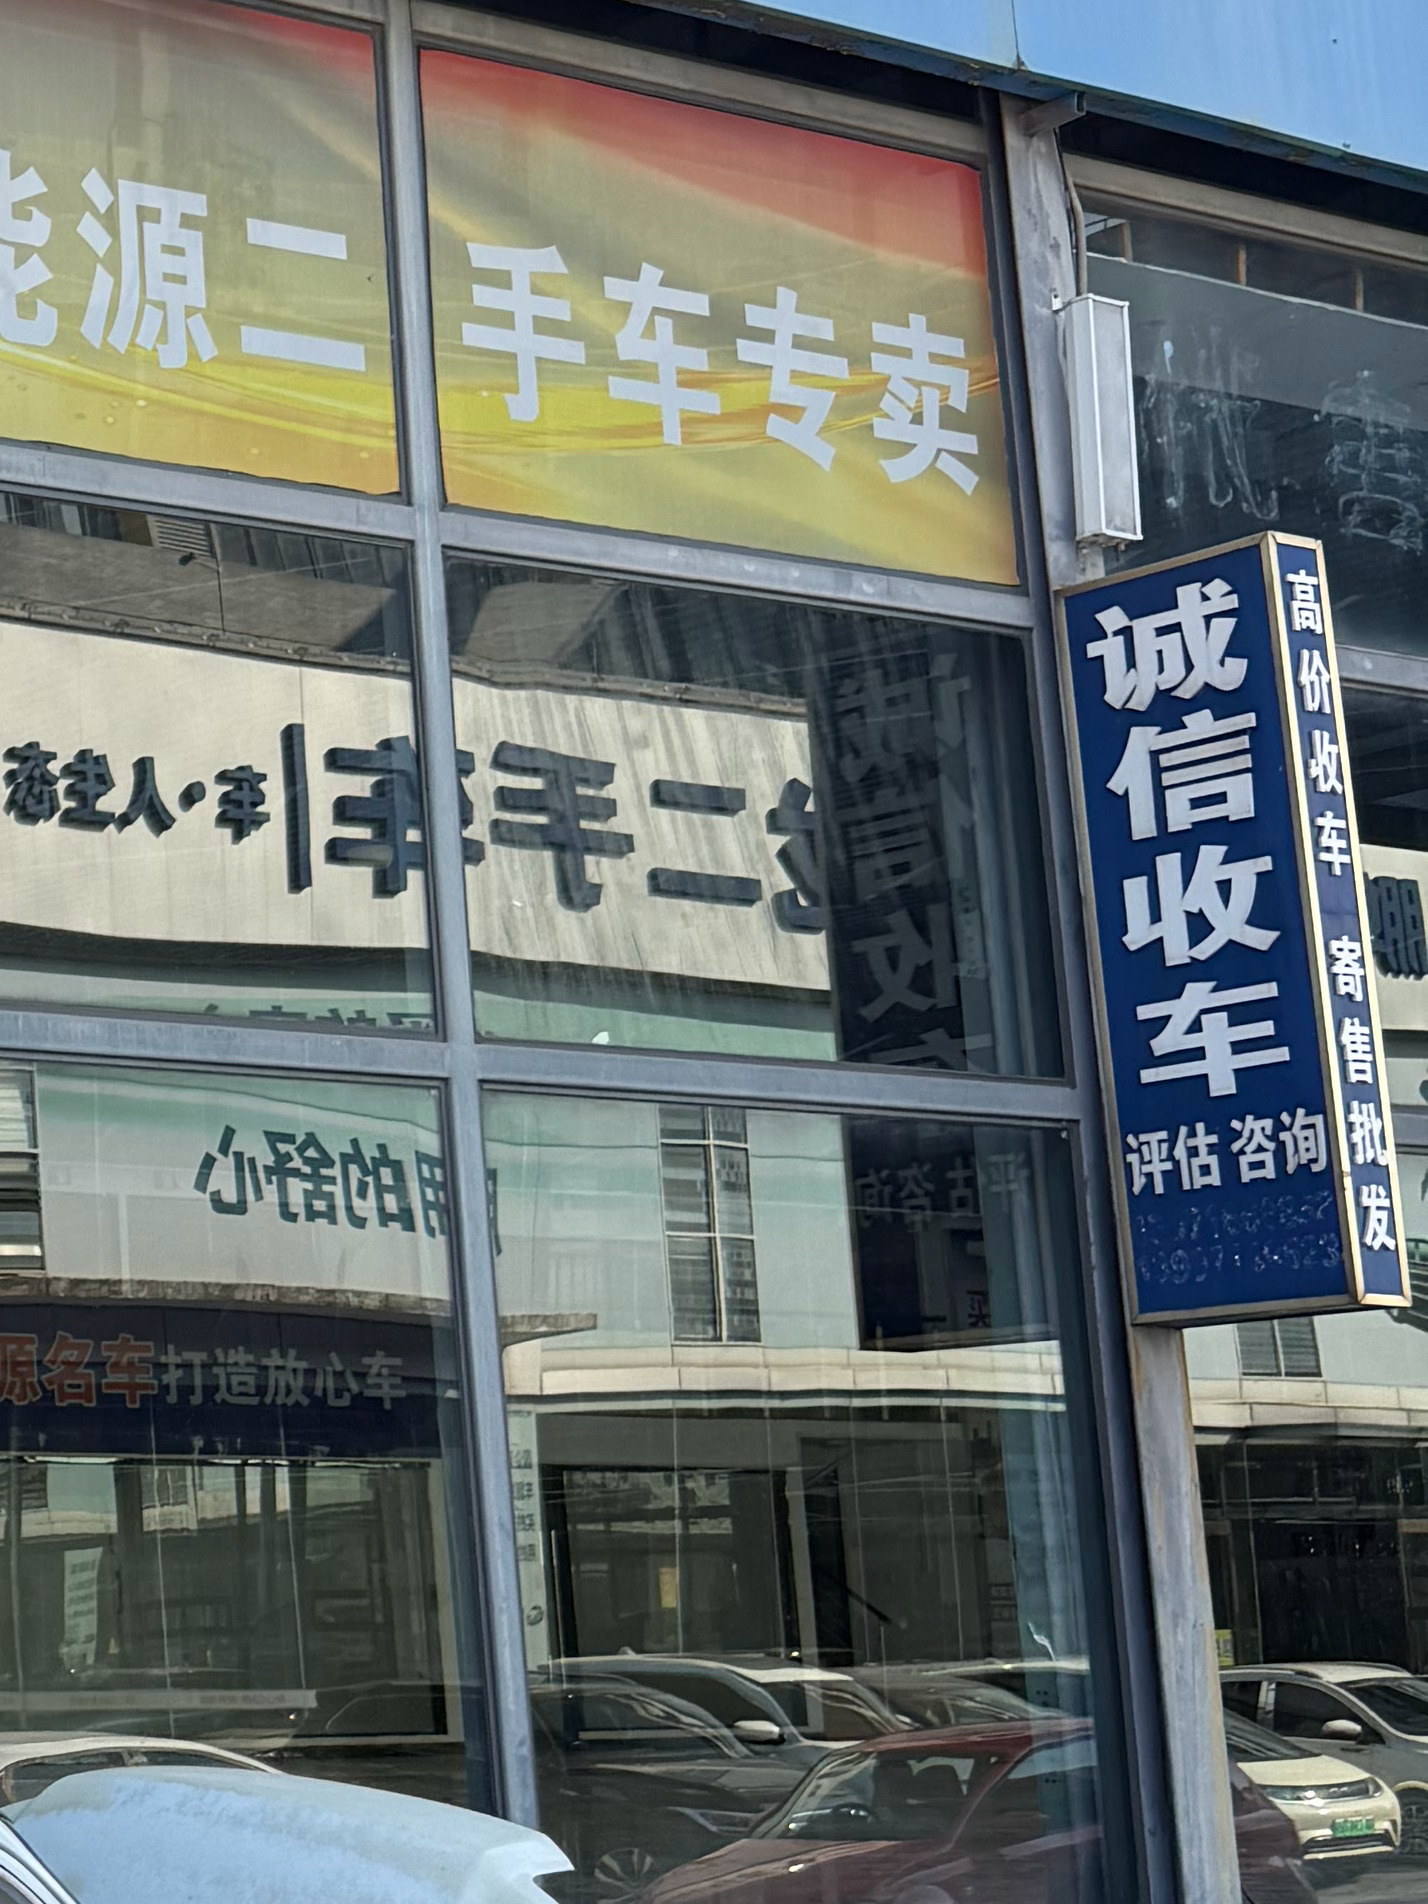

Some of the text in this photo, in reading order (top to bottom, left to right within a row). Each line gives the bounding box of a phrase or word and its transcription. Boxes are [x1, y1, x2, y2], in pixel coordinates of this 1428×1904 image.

[1085, 576, 1292, 1099] 诚信收车
[1285, 568, 1351, 877] 高价收车
[1328, 934, 1398, 1252] 寄售批发
